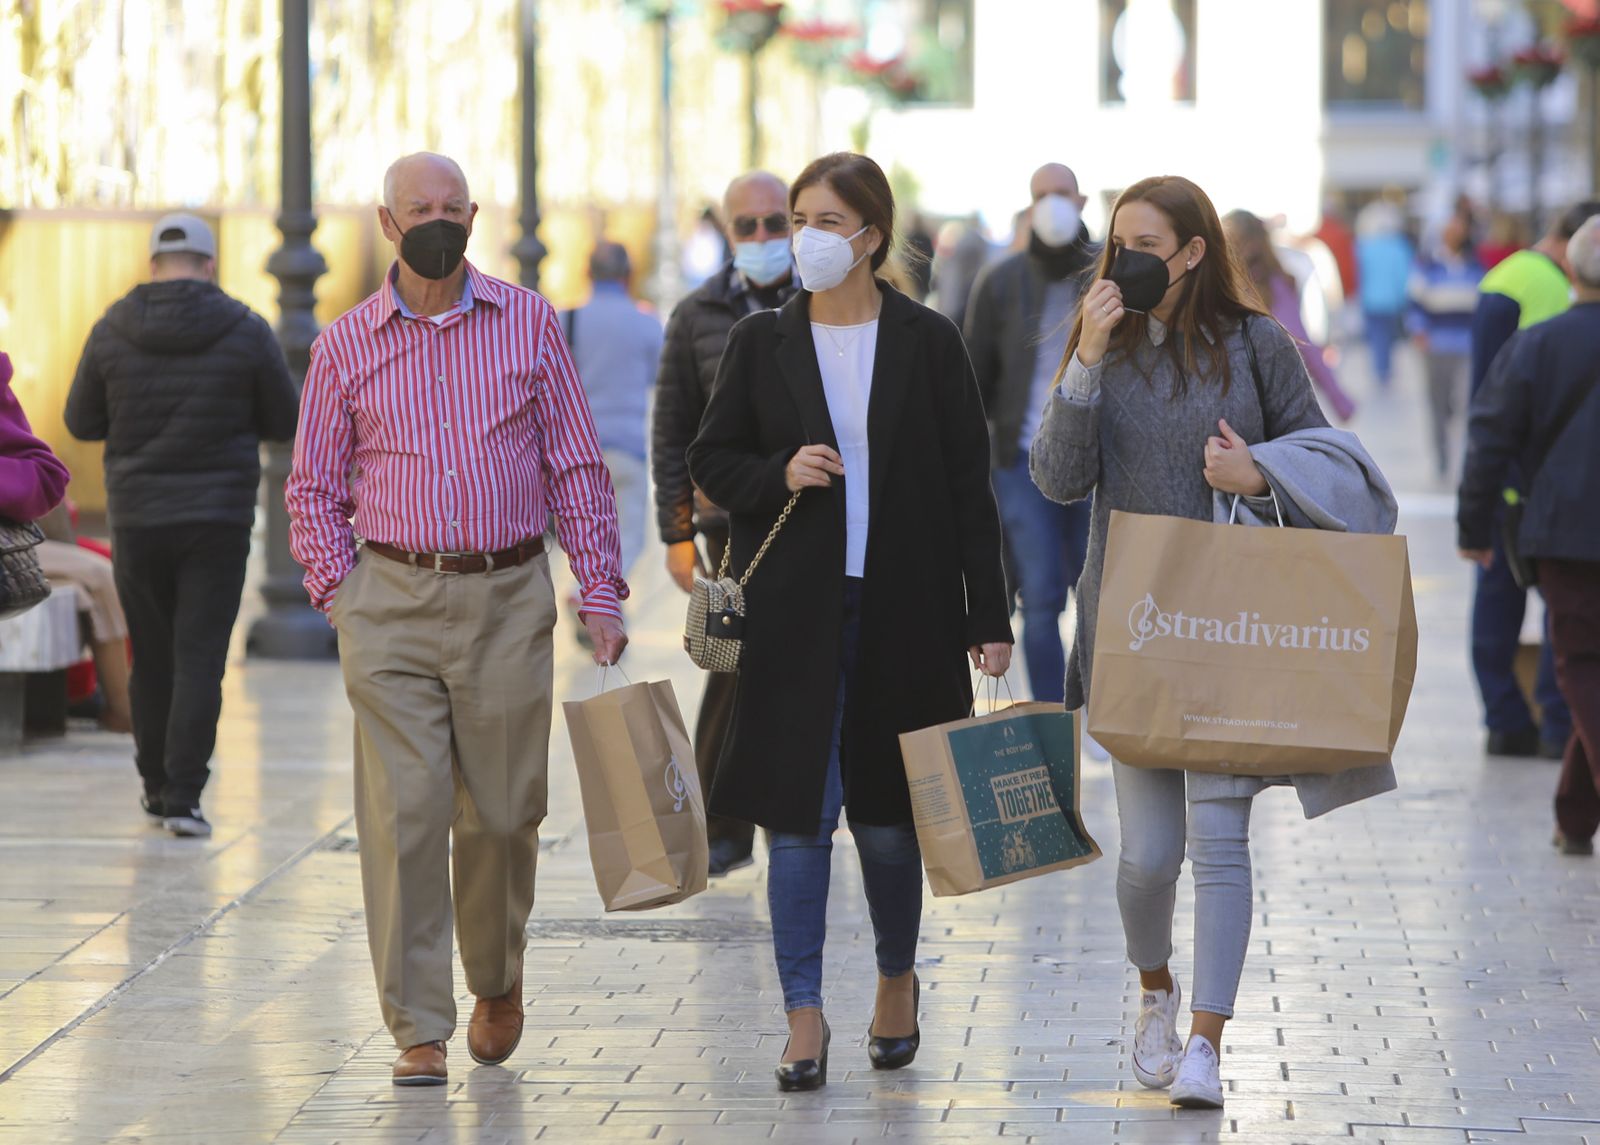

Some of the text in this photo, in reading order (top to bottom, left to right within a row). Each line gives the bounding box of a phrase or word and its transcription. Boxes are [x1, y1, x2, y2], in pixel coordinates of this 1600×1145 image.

[1155, 611, 1369, 652] stradivarius
[1183, 713, 1298, 729] WWW.STRADIVARIUS.COM
[993, 769, 1048, 789] MAKE IT REA
[997, 781, 1058, 819] TOGETHE
